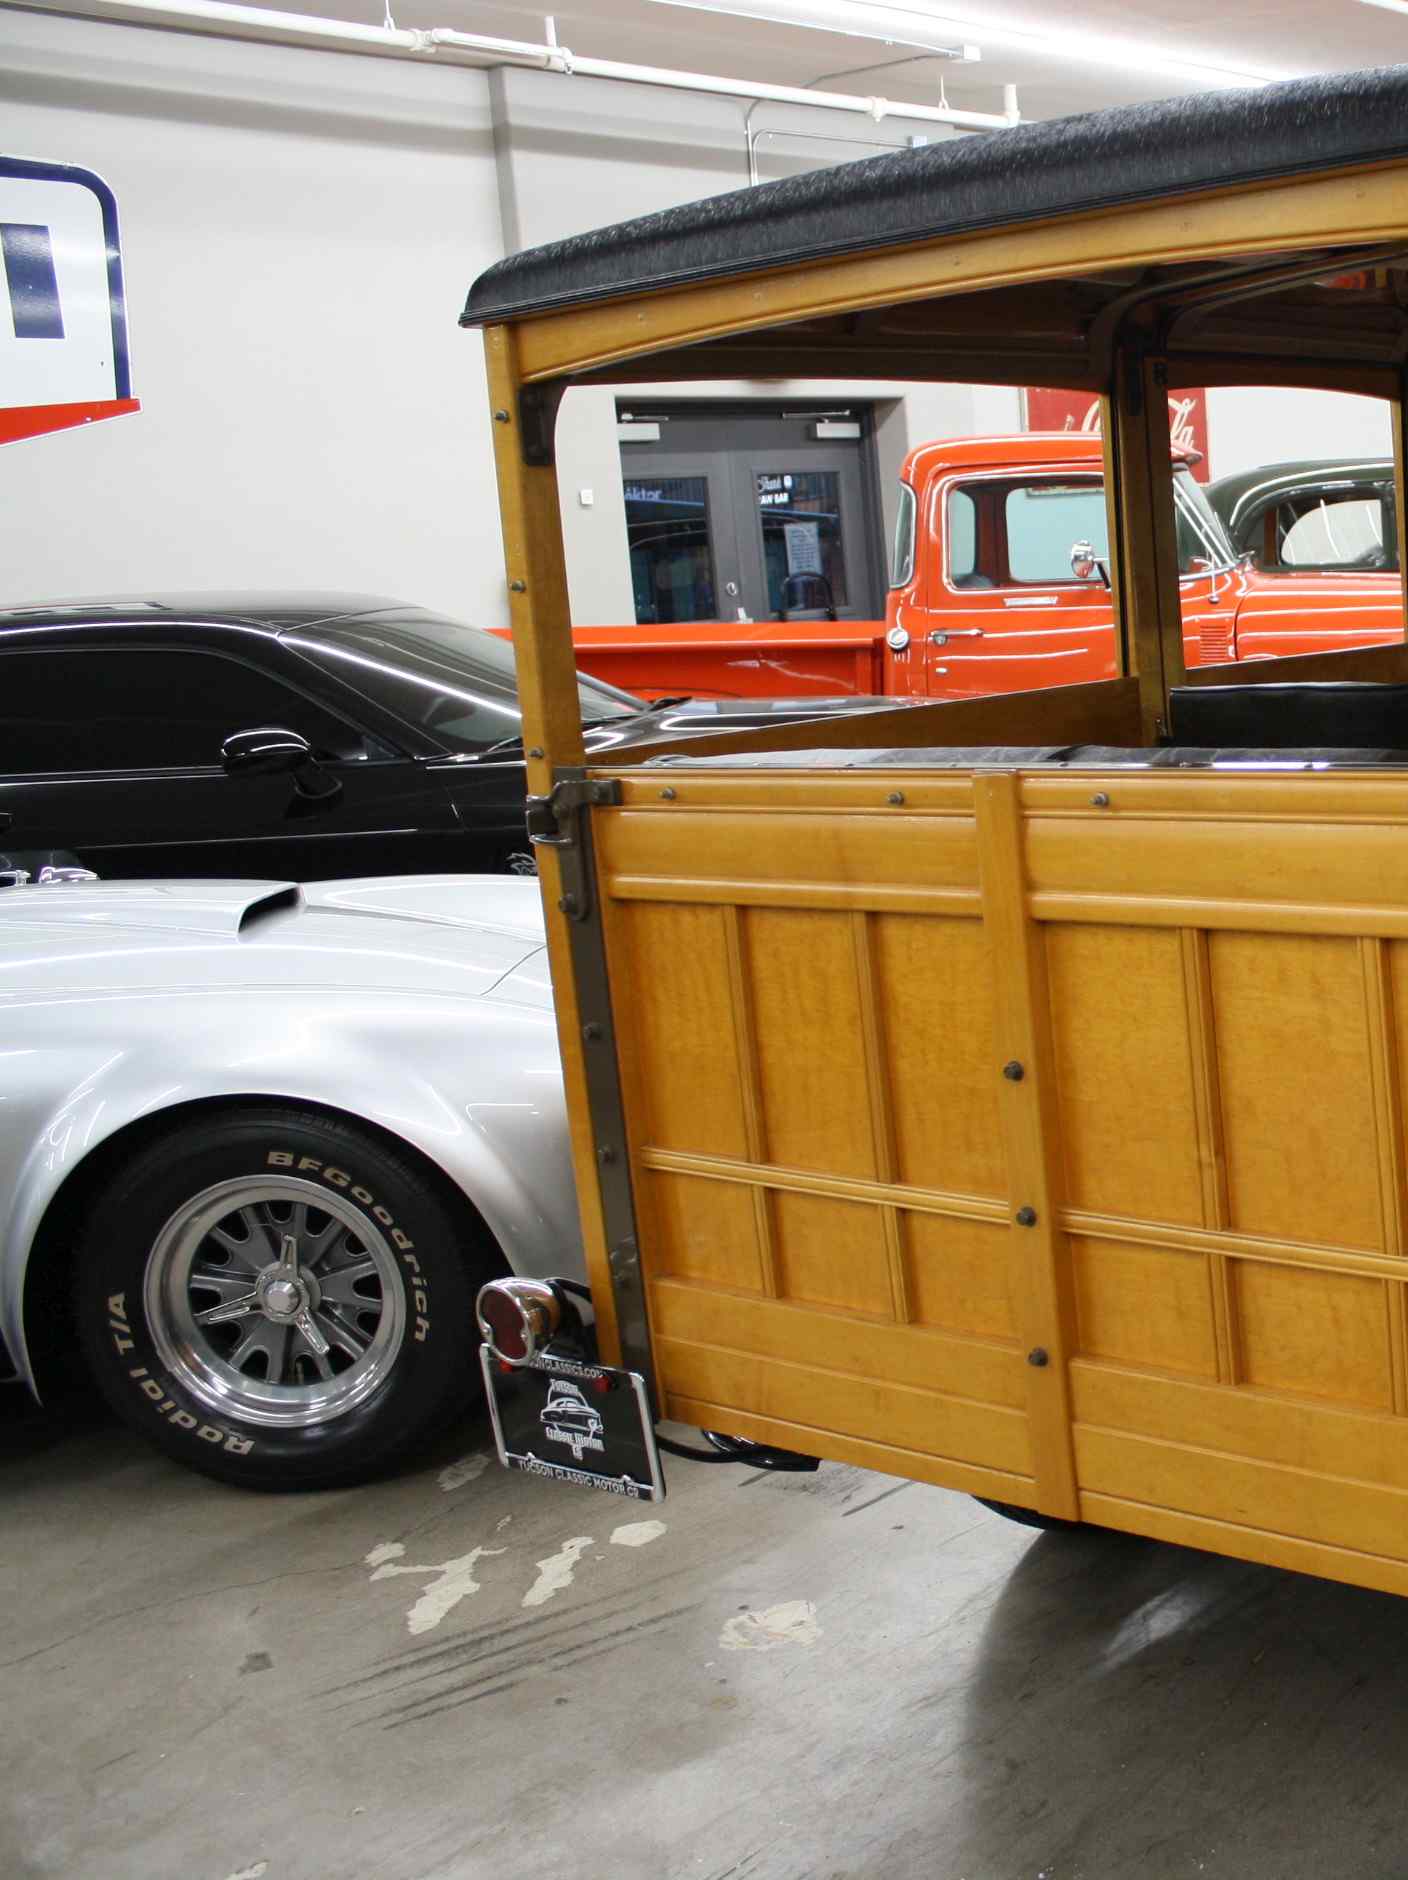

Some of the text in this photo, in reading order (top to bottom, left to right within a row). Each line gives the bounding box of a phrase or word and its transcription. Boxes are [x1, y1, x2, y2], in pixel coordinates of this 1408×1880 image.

[267, 1151, 430, 1342] BFGoodrich
[108, 1293, 256, 1456] Radial T/A
[518, 1460, 554, 1480] TUCSON
[554, 1468, 593, 1487] CLASSIC
